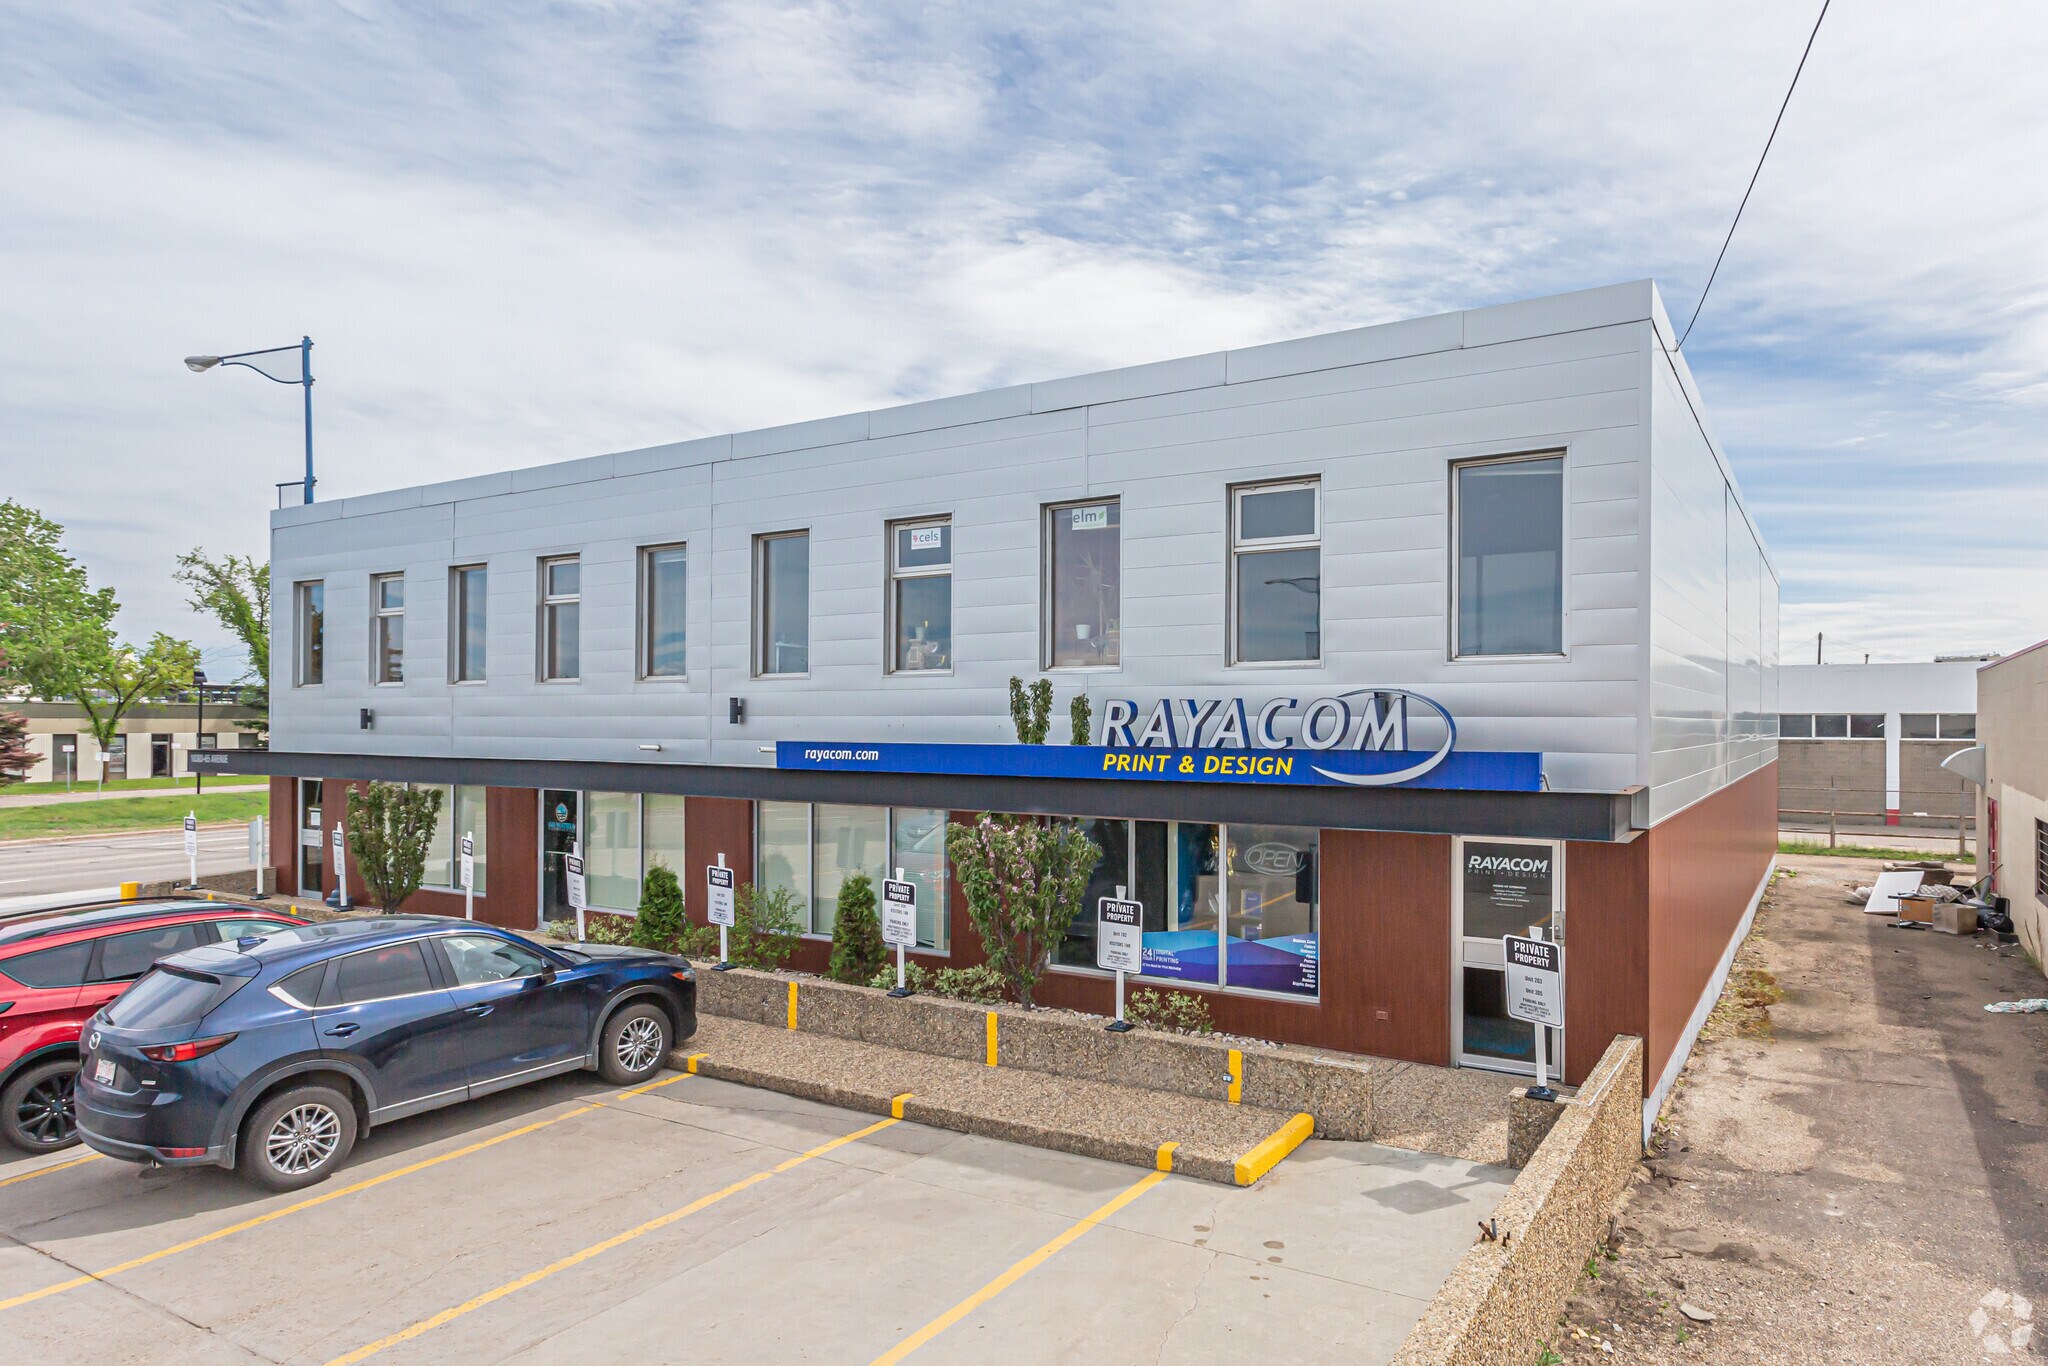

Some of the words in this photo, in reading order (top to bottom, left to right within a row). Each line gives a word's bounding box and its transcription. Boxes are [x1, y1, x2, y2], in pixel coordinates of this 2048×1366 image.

[1073, 509, 1096, 523] elm
[919, 530, 939, 542] cels
[1100, 697, 1408, 751] RAYACOM
[804, 749, 878, 762] rayacom.com
[1102, 754, 1170, 773] PRINT
[1179, 756, 1195, 774] &
[1204, 756, 1293, 776] DESIGN
[1248, 849, 1304, 868] OPEN
[1468, 856, 1548, 872] RAYACOM
[889, 884, 910, 894] PRIVATE
[889, 892, 910, 902] PROPERTY
[1107, 903, 1134, 914] PRIVATE
[1107, 913, 1134, 923] PROPERTY
[1142, 948, 1152, 956] 24
[1514, 941, 1550, 958] PRIVATE
[1156, 956, 1179, 964] PRINTING
[1514, 953, 1550, 967] PROPERTY
